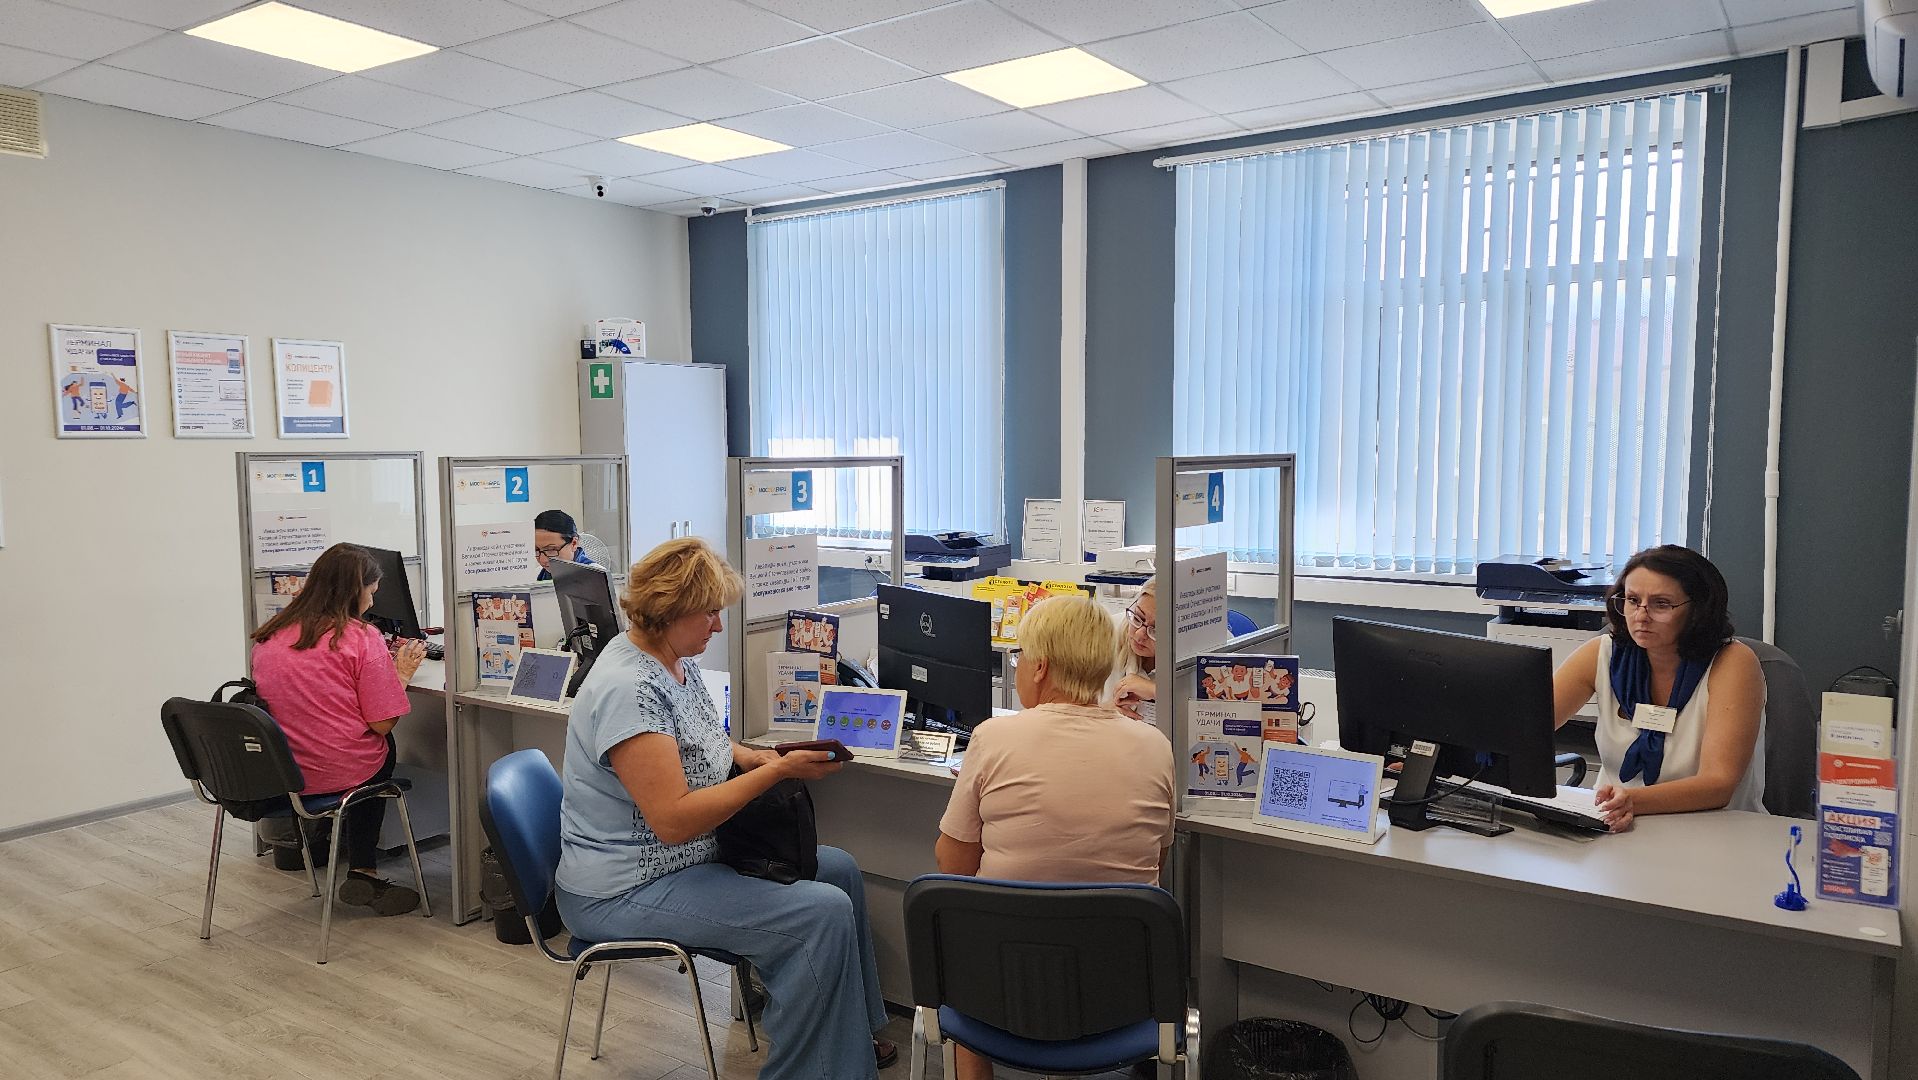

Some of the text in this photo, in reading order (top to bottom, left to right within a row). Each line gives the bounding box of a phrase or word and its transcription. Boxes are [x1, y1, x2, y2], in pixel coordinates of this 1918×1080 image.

[308, 468, 320, 486] 1
[511, 476, 523, 495] 2
[797, 480, 808, 503] 3
[1211, 485, 1220, 512] 4
[1196, 711, 1237, 719] ТЕРМИНАЛ
[1196, 719, 1221, 727] УДАЧИ
[1828, 812, 1877, 826] АКЦИЯ
